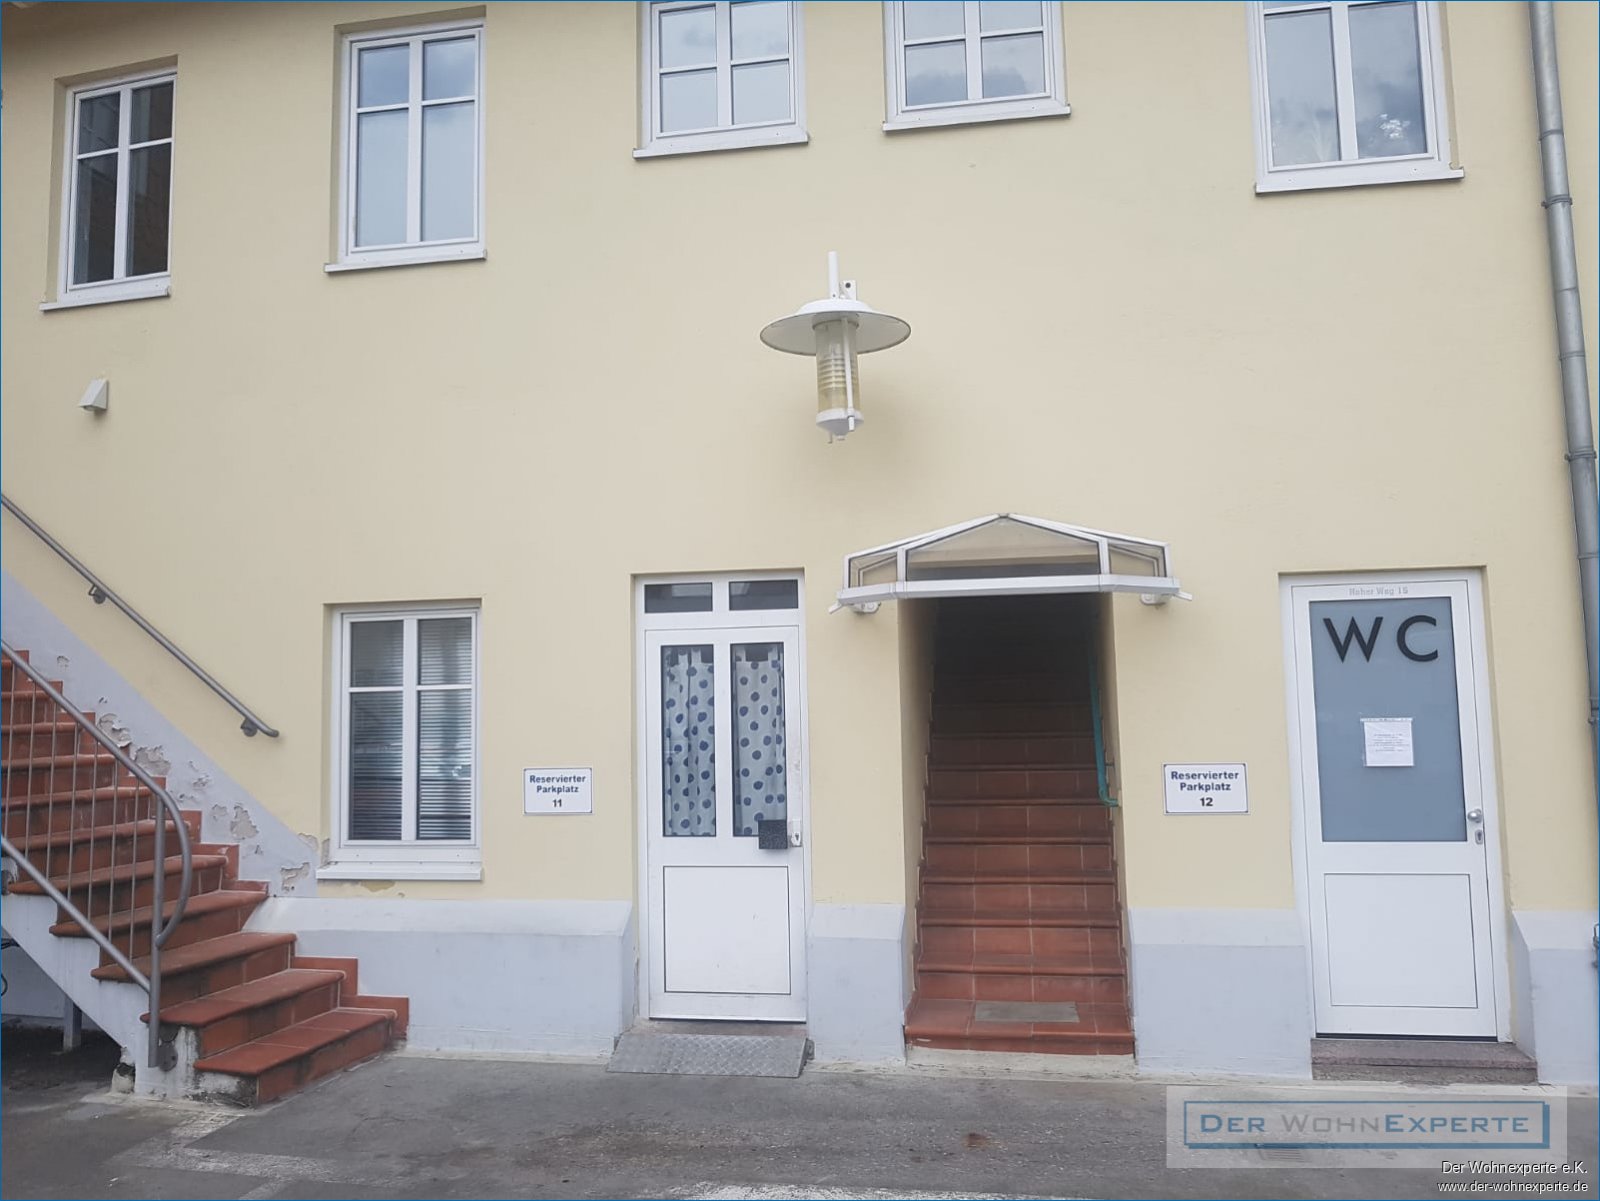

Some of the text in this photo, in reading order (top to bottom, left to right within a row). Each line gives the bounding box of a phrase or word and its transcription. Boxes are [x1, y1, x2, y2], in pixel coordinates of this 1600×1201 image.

[1322, 614, 1438, 663] WC
[529, 774, 586, 783] Reservierter
[1170, 771, 1239, 780] Reservierter
[536, 785, 580, 795] Parkplatz
[1180, 782, 1232, 793] Parkplatz
[552, 798, 563, 808] 11
[1199, 797, 1214, 807] 12
